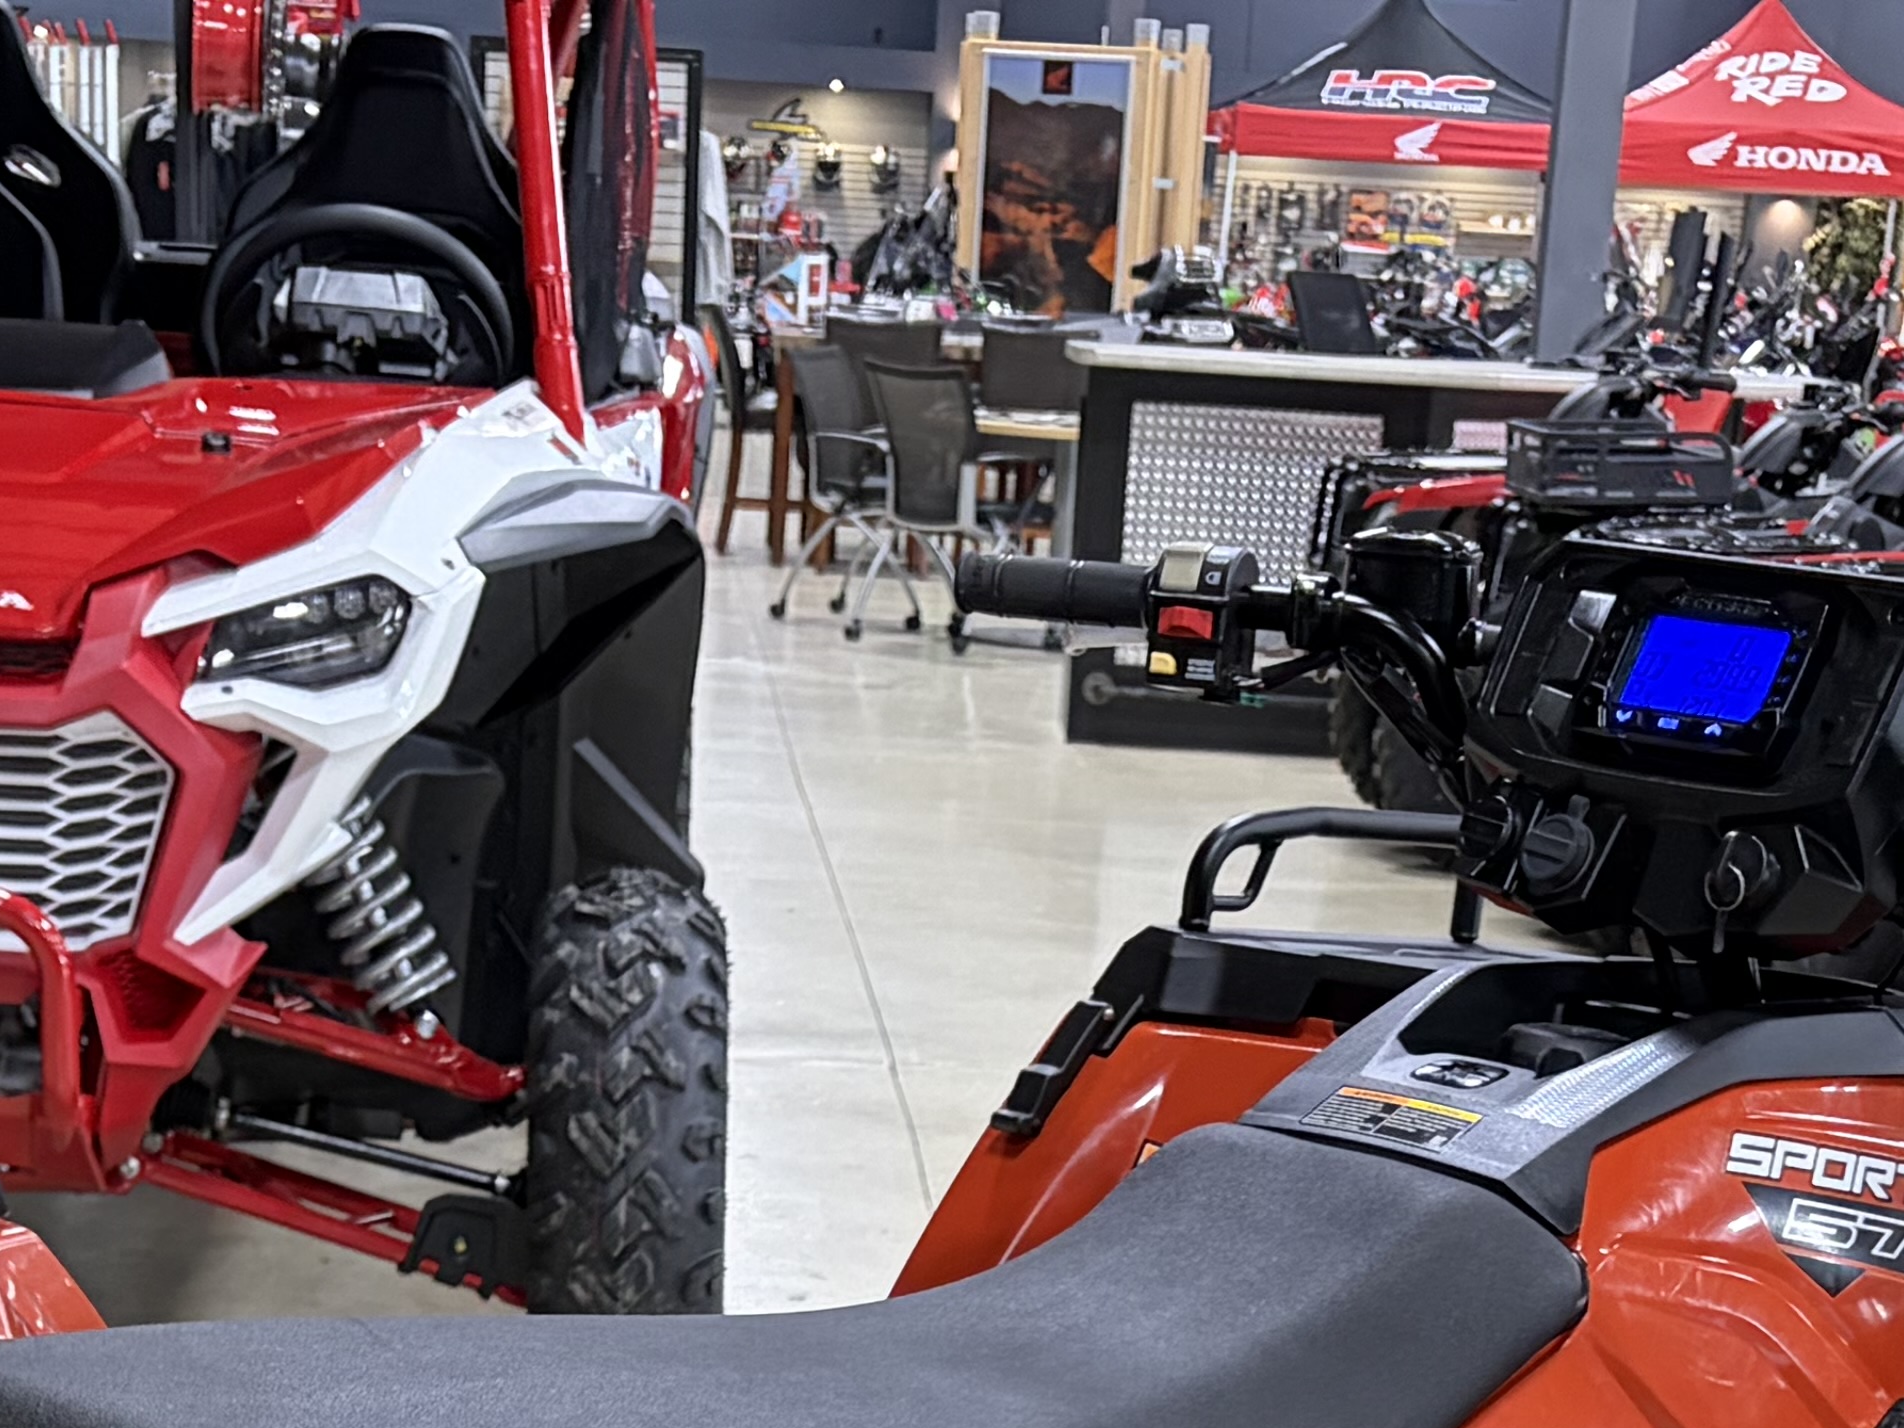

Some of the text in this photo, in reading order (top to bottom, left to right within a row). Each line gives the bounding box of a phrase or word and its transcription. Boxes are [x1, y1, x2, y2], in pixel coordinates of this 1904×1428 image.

[1714, 49, 1823, 81] RIDE
[1320, 69, 1497, 106] HRC
[1730, 74, 1848, 107] RED
[1733, 144, 1892, 177] HONDA
